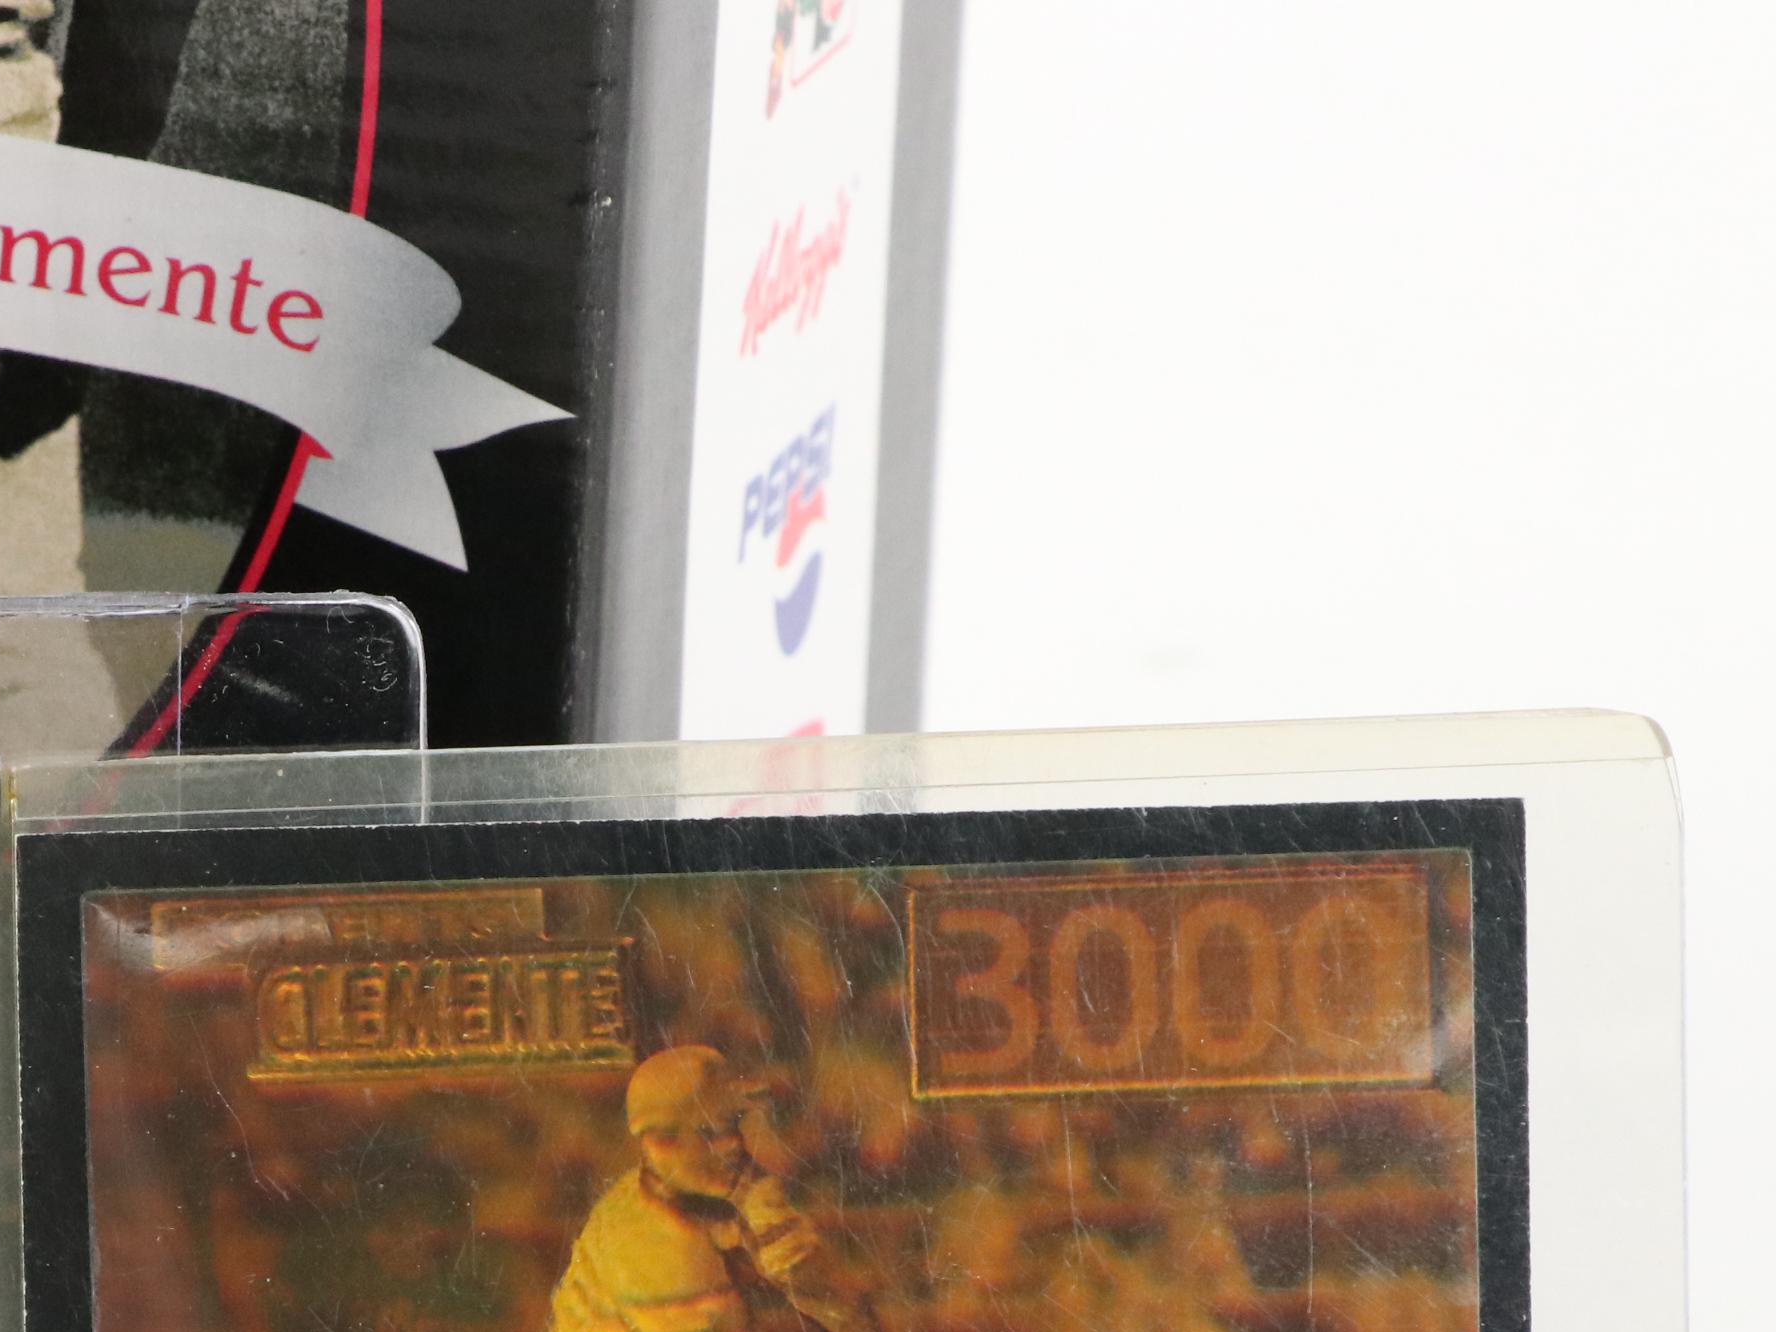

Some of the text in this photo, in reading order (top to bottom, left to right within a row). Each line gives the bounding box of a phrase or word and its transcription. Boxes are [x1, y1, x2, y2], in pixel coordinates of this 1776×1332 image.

[737, 400, 837, 564] PEPSI
[258, 953, 626, 1053] CLEMENTE
[935, 896, 1409, 1076] 3000
